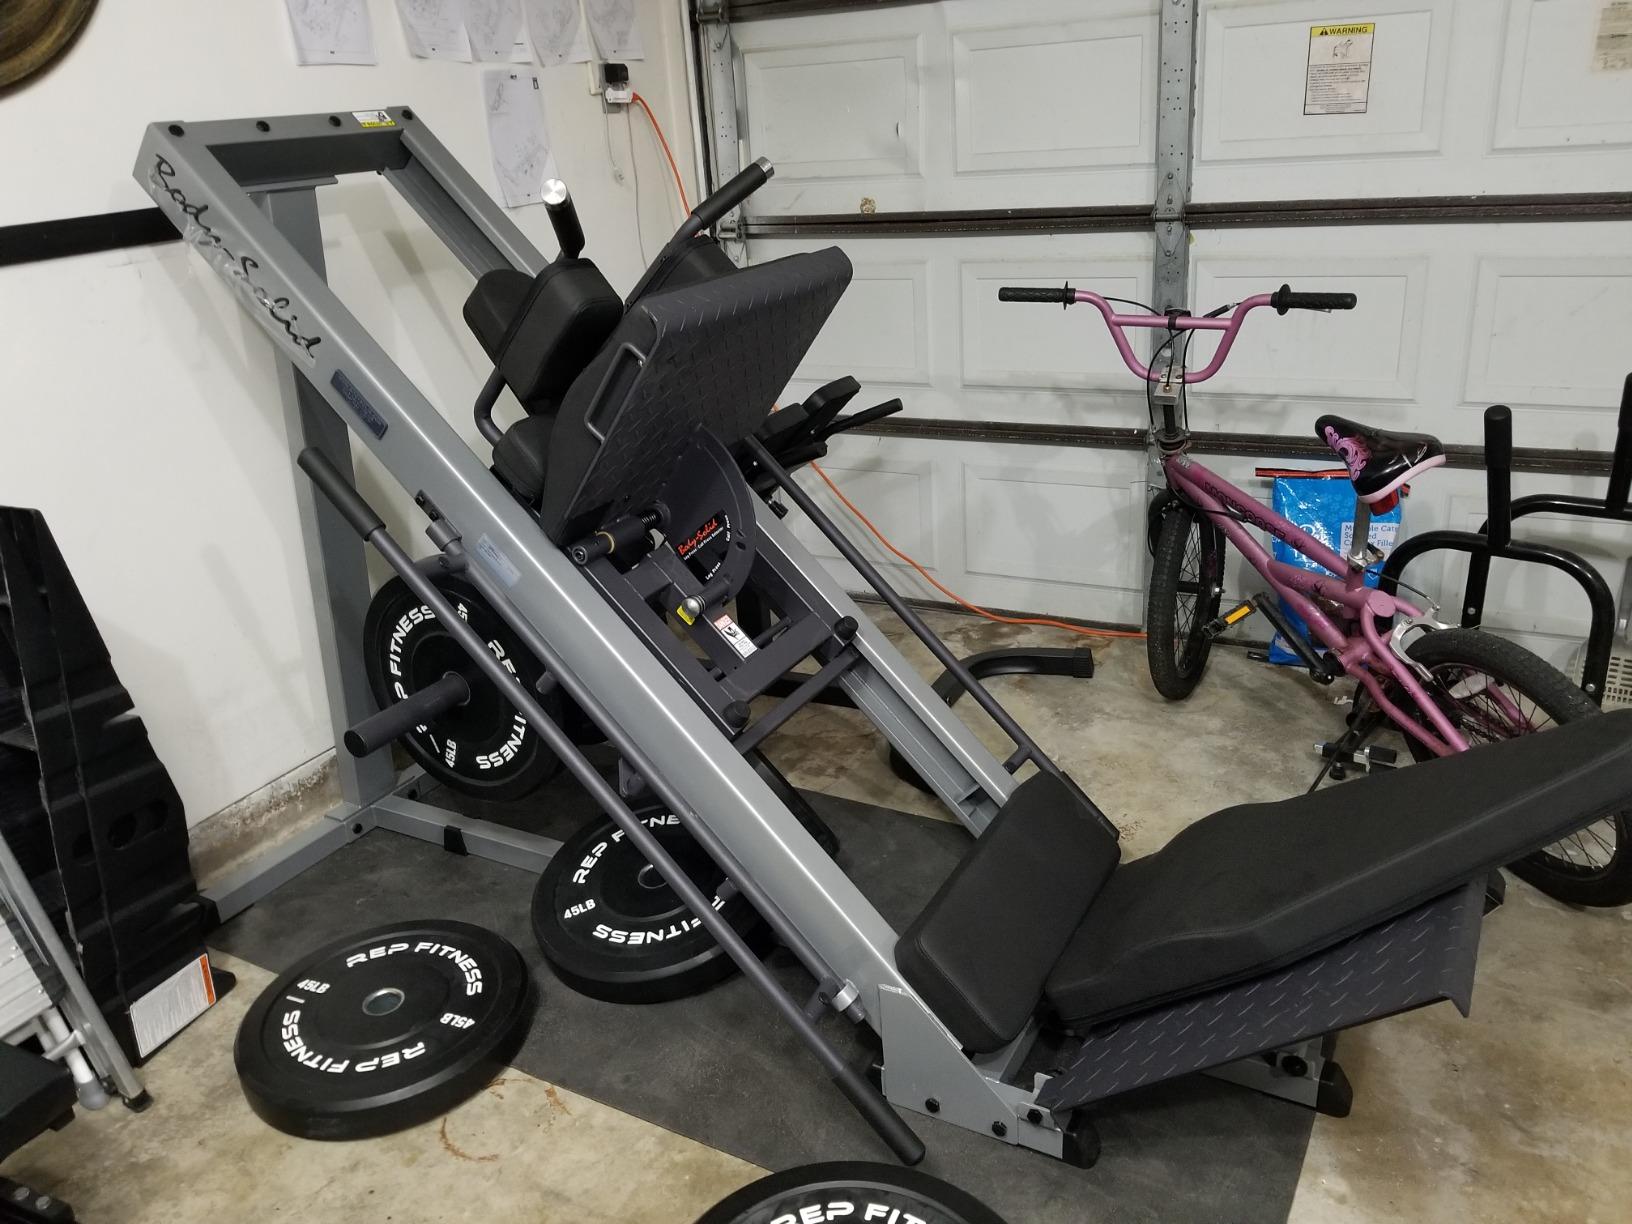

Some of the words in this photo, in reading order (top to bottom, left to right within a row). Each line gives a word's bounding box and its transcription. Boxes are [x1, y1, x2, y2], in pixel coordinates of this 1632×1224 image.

[1329, 26, 1368, 36] WARNING
[678, 517, 718, 556] Body-Solid
[705, 572, 714, 581] Leg
[712, 561, 722, 573] Press
[389, 604, 436, 677] FITNESS
[444, 738, 458, 769] 45LB
[475, 711, 528, 770] ITNESS
[572, 841, 608, 884] REP
[563, 898, 597, 920] 45LB
[345, 942, 410, 968] REP
[414, 941, 484, 997] FITNESS
[296, 978, 332, 995] 45LB
[439, 1011, 476, 1031] 45LB
[281, 1009, 351, 1074] FITNESS
[354, 1041, 427, 1074] REP
